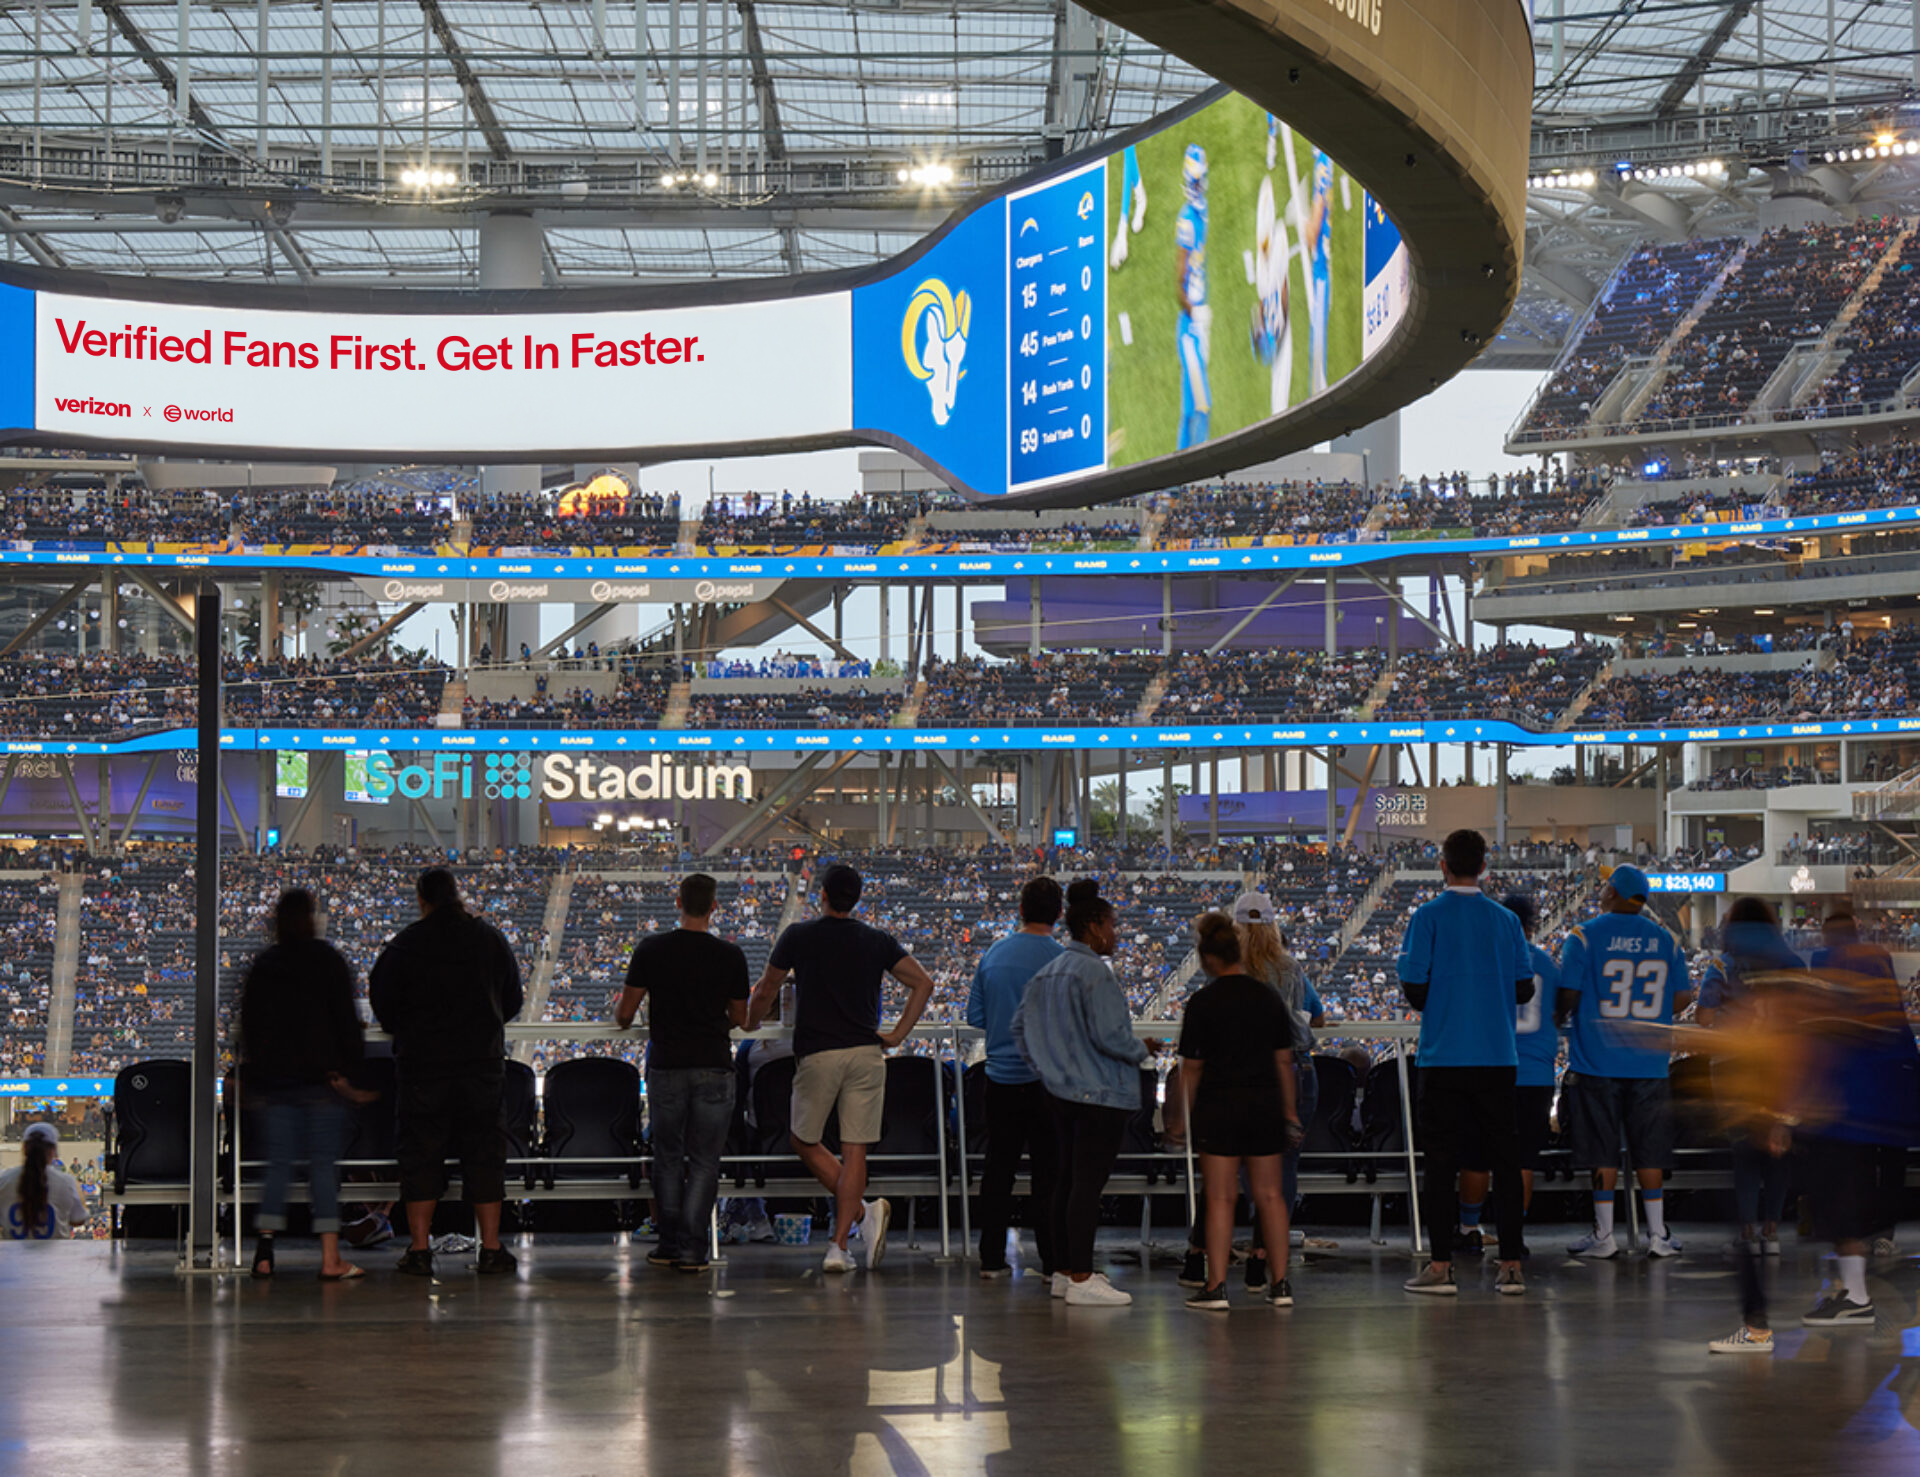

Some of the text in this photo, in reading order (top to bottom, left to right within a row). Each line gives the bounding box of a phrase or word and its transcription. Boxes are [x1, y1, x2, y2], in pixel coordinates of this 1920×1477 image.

[1022, 282, 1037, 308] 15
[1081, 265, 1091, 291] 0
[55, 318, 705, 371] Verified Fans First. Get In Faster.
[1020, 330, 1038, 357] 45
[1081, 314, 1091, 340] 0
[1022, 379, 1037, 405] 14
[1081, 364, 1091, 390] 0
[54, 396, 131, 417] verizon
[184, 407, 234, 422] world
[1020, 427, 1038, 455] 59
[1081, 413, 1091, 439] 0
[56, 513, 1867, 573] RAMS RAMS RAMS RAMS RAMS RAMS RAMS RAMS RAMS RAMS RAMS RAMS RAMS RAMS RAMS
[405, 584, 443, 597] pepsi
[510, 584, 549, 598] pepsi
[611, 584, 650, 598] pepsi
[716, 584, 754, 598] pepsi
[8, 743, 43, 752] RAMS
[322, 736, 356, 744] RAMS
[442, 736, 476, 745] RAMS
[560, 737, 594, 745] RAMS
[678, 736, 712, 745] RAMS
[796, 736, 829, 744] RAMS
[914, 735, 947, 743] RAMS
[1042, 734, 1075, 743] RAMS
[1159, 733, 1191, 741] RAMS
[1273, 730, 1306, 739] RAMS
[1389, 728, 1425, 737] RAMS
[1573, 733, 1606, 742] RAMS
[1689, 729, 1719, 739] RAMS
[1792, 724, 1822, 734] RAMS
[364, 753, 752, 799] SoFi Stadium
[1375, 793, 1410, 812] SoFi
[1375, 812, 1427, 826] CIRCLE
[1607, 936, 1659, 953] JAMES JR
[1599, 959, 1668, 1019] 33
[0, 1083, 31, 1092] AMS
